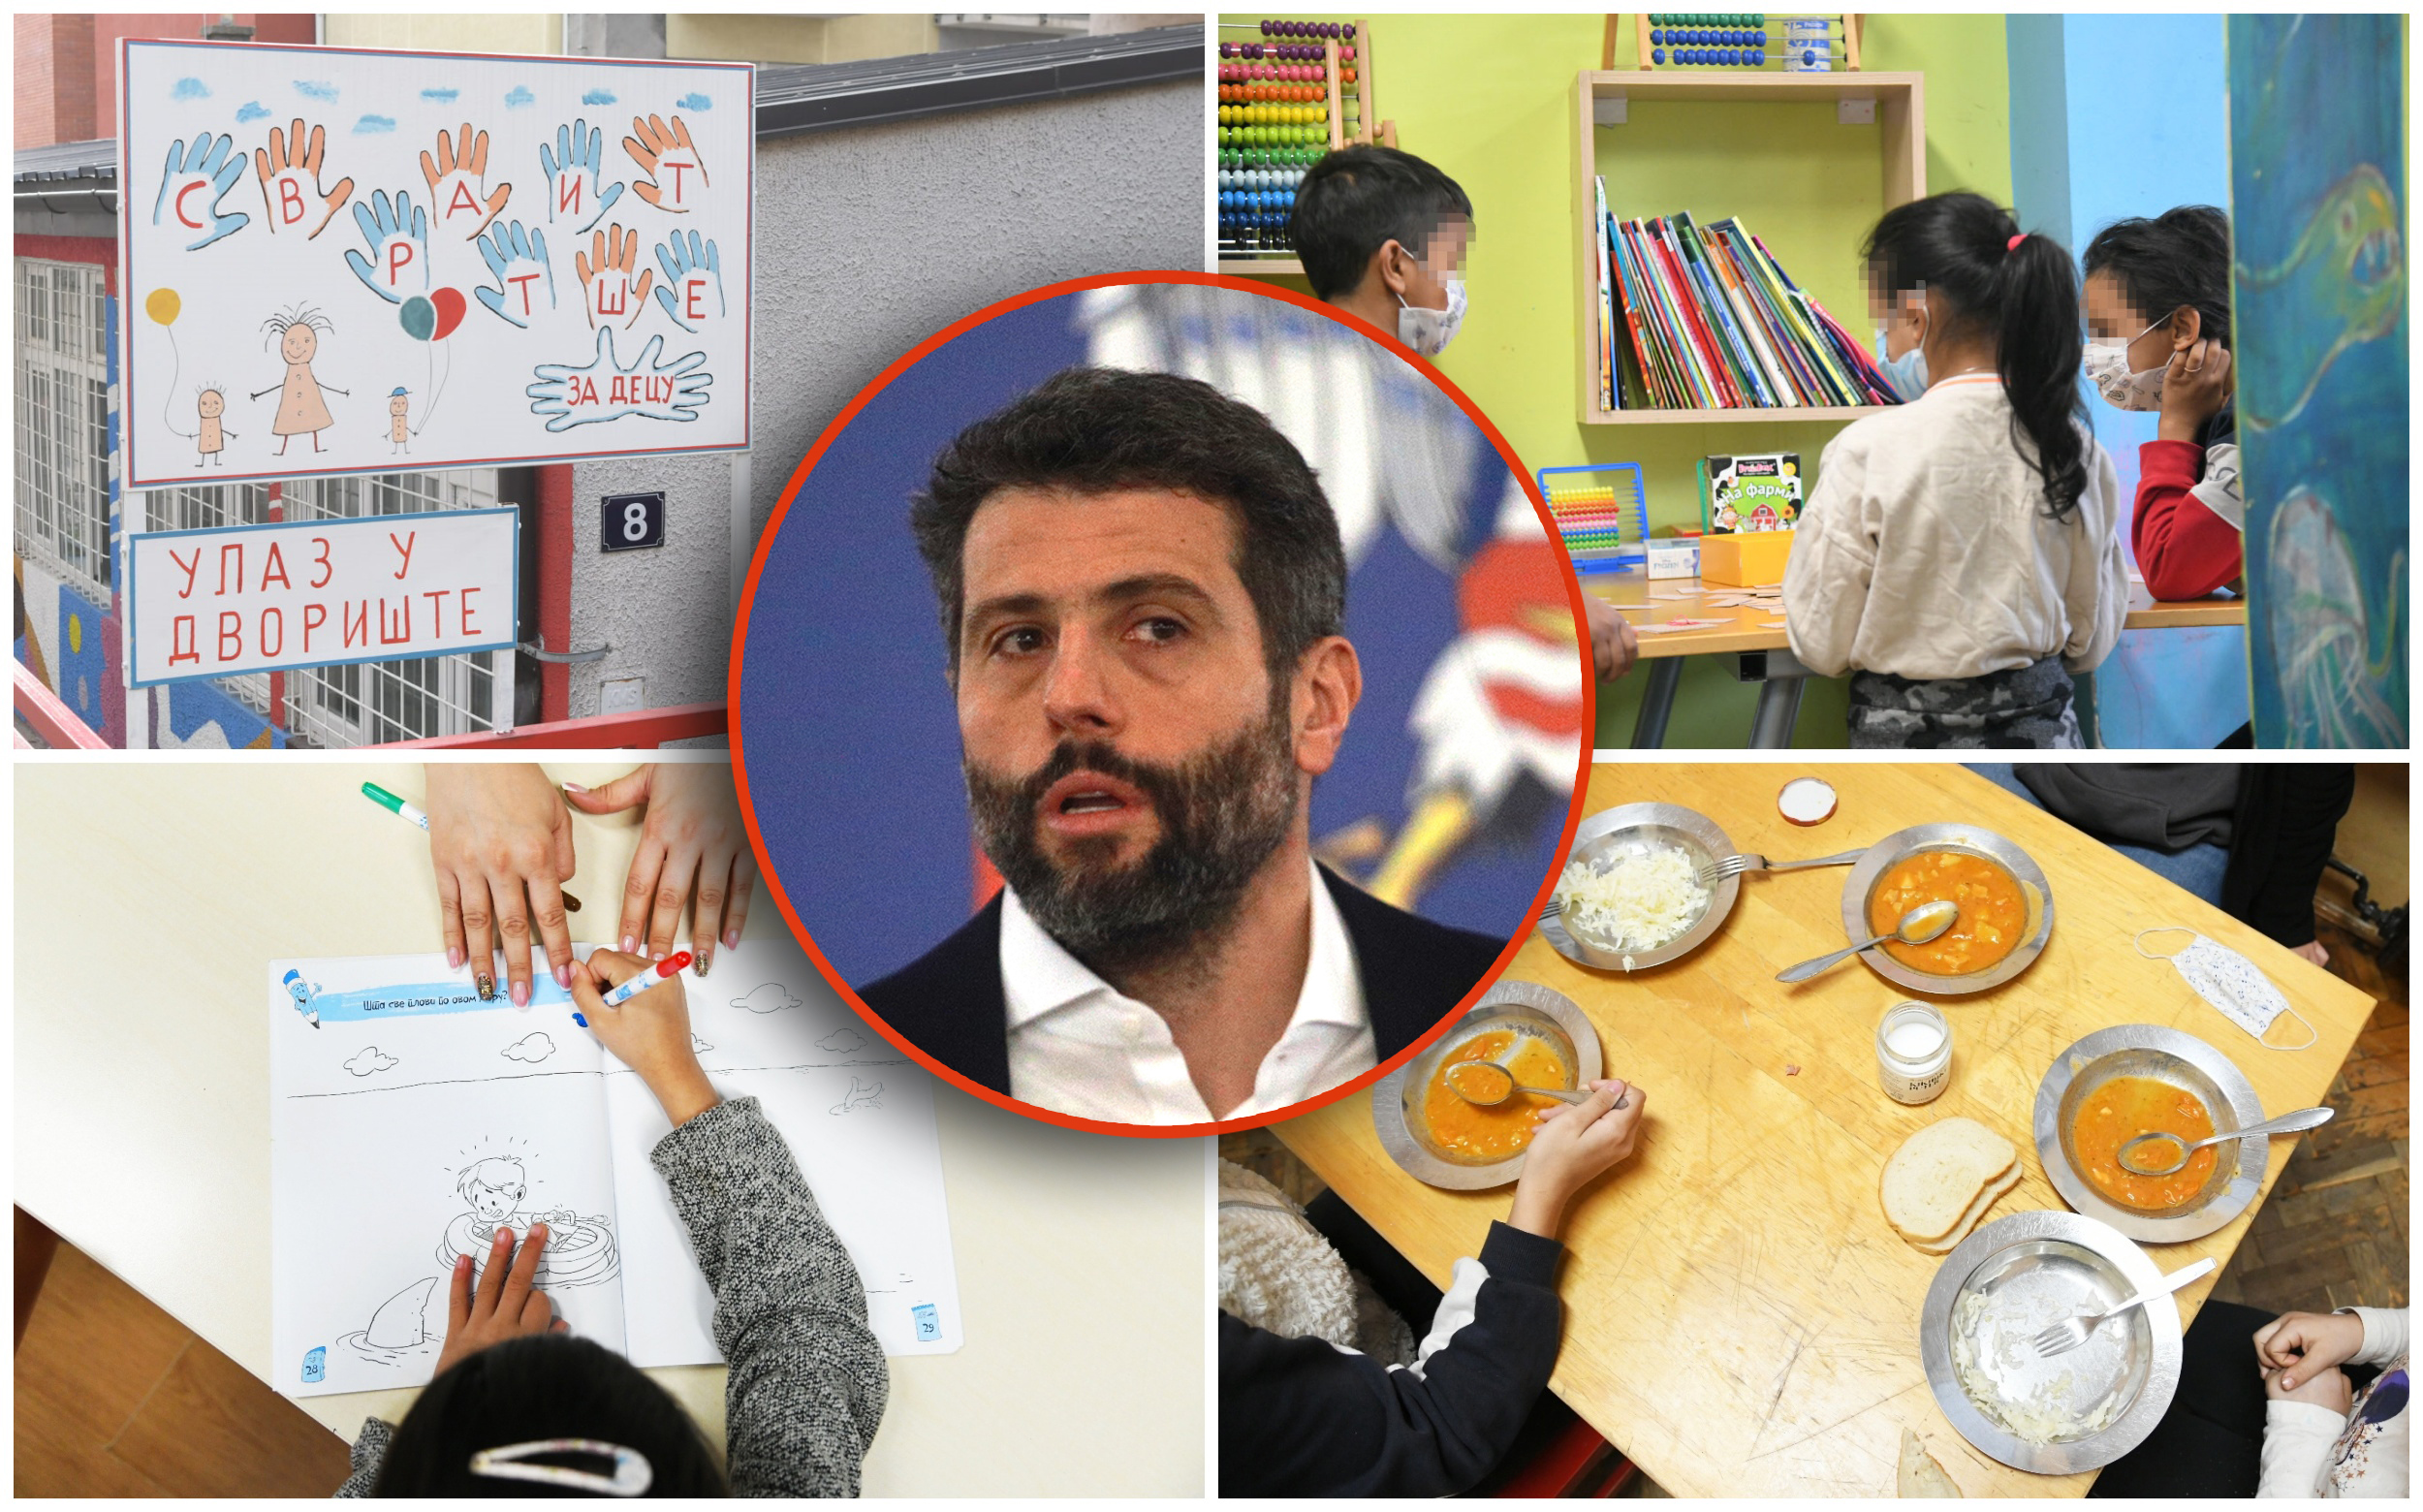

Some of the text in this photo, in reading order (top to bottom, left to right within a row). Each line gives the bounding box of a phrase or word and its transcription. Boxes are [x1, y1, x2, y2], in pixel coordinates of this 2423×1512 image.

[567, 375, 674, 406] ЗА ДЕЦУ
[1720, 482, 1796, 504] На фарми
[622, 501, 647, 542] 8
[169, 530, 415, 599] УЛАЗ У
[168, 587, 482, 667] ДВОРИШТЕ
[363, 999, 386, 1011] Шта
[407, 997, 436, 1008] плови
[452, 994, 477, 1004] овом
[479, 990, 508, 1004] ру?
[922, 1323, 934, 1333] 29
[305, 1365, 319, 1375] 28
